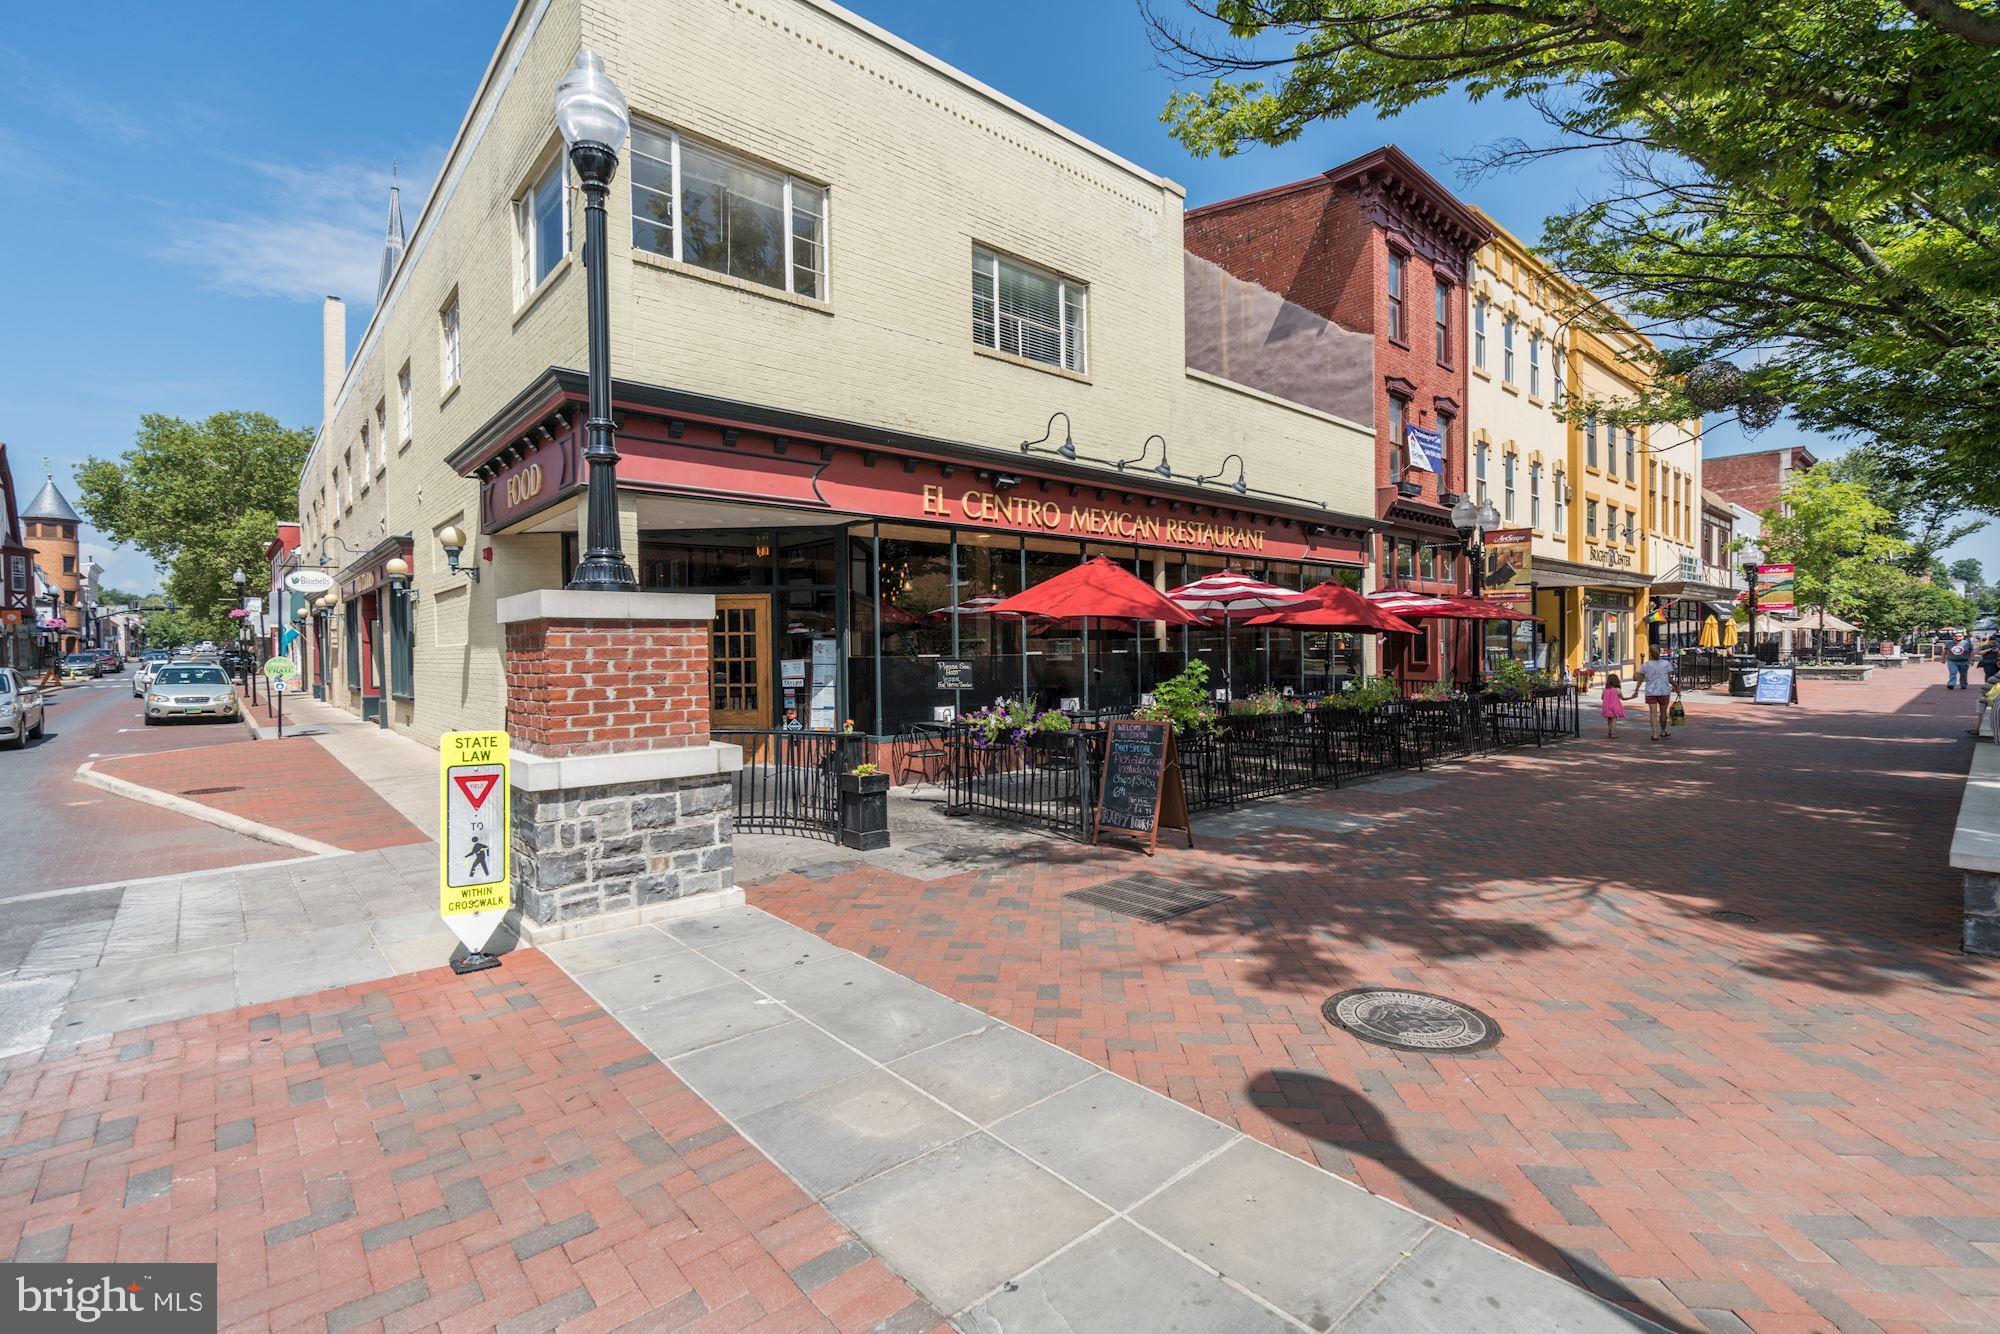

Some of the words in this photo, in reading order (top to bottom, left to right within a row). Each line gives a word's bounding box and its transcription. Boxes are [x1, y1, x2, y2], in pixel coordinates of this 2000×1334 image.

[507, 463, 541, 508] FOOD
[923, 484, 951, 516] EL
[961, 490, 1061, 530] CENTRO
[1070, 505, 1160, 541] MEXICAN
[1166, 518, 1266, 552] RESTAURANT
[455, 736, 498, 749] STATE
[462, 750, 491, 762] LAW
[470, 822, 484, 831] TO
[461, 887, 493, 898] WITHIN
